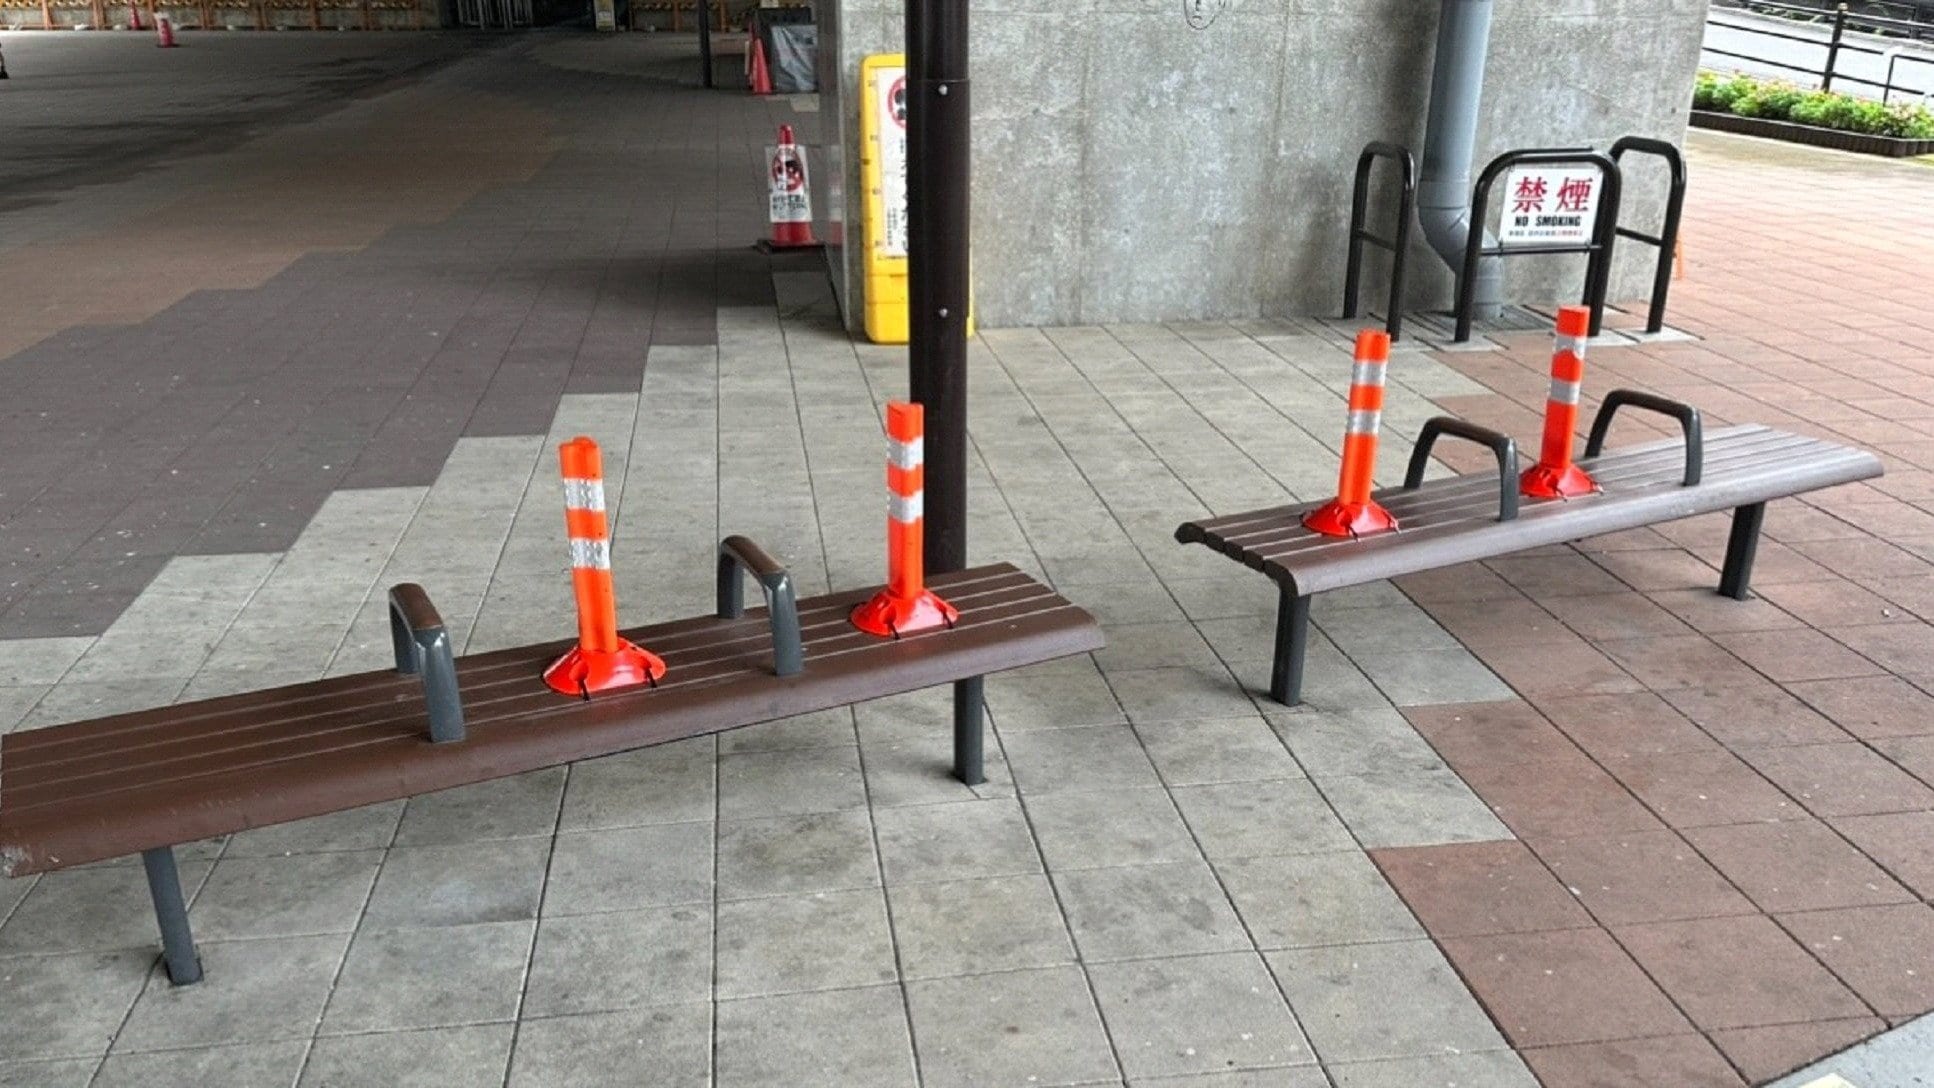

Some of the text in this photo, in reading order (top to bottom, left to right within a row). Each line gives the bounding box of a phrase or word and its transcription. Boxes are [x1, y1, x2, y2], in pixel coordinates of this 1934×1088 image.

[1512, 176, 1593, 213] 禁煙
[1515, 216, 1581, 227] NO SMOKING
